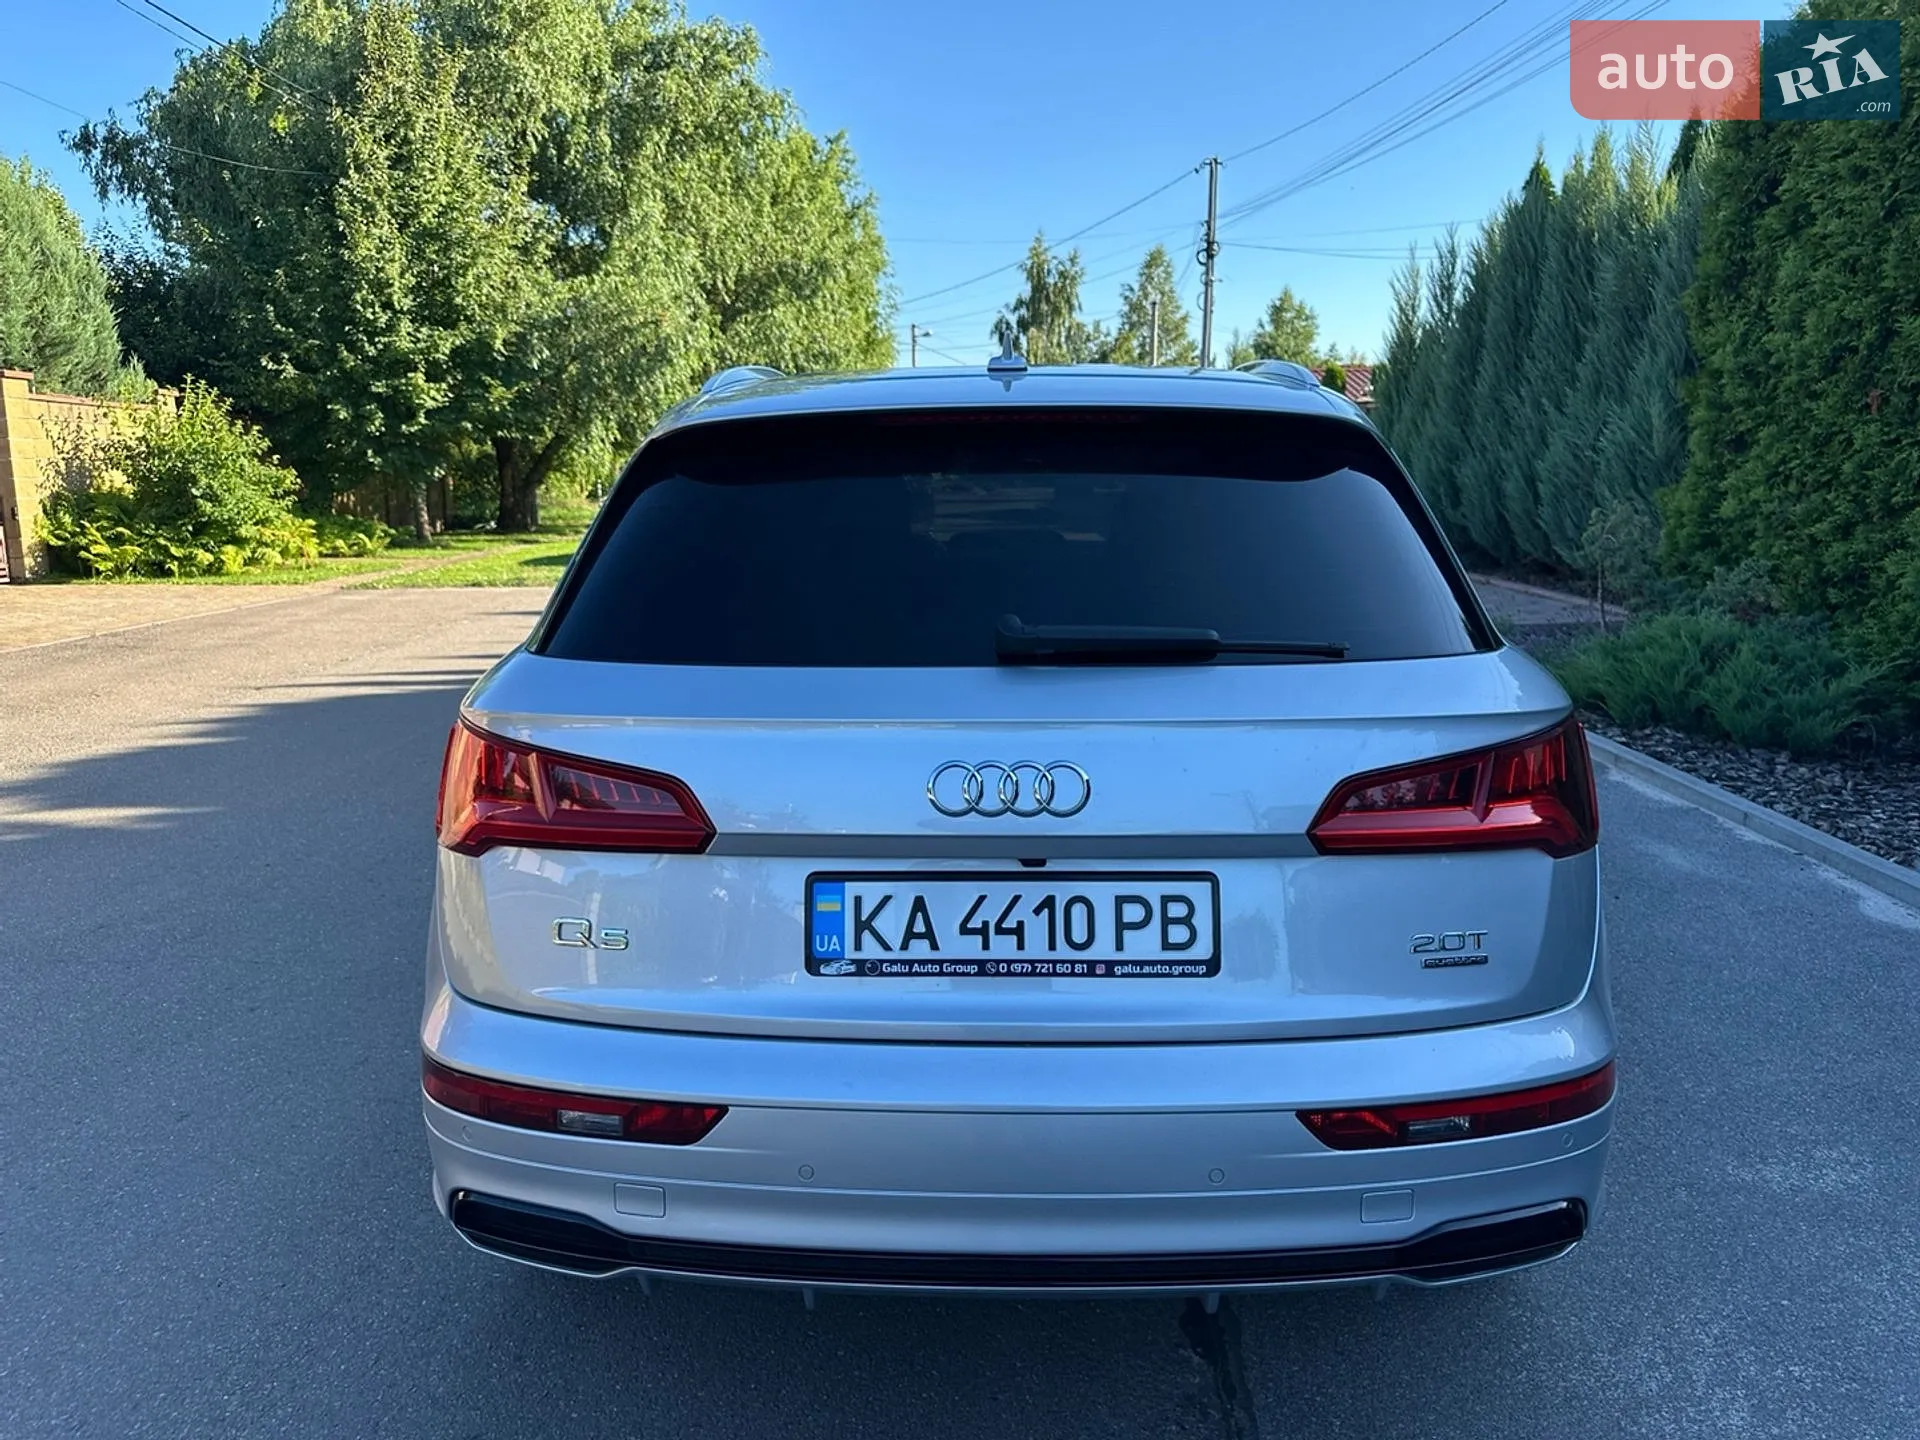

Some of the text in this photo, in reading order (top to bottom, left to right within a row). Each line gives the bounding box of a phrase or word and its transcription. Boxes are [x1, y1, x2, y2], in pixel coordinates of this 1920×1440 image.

[552, 917, 629, 950] Q5
[853, 894, 1198, 951] KA 4410 PB
[816, 935, 841, 951] UA
[882, 963, 908, 973] Galu
[911, 963, 940, 973] Auto
[942, 963, 978, 975] Group
[999, 963, 1007, 973] 0
[1034, 963, 1053, 973] 721
[1055, 963, 1072, 973] 60
[1074, 963, 1088, 973] 81
[1113, 963, 1207, 975] galu.auto.group
